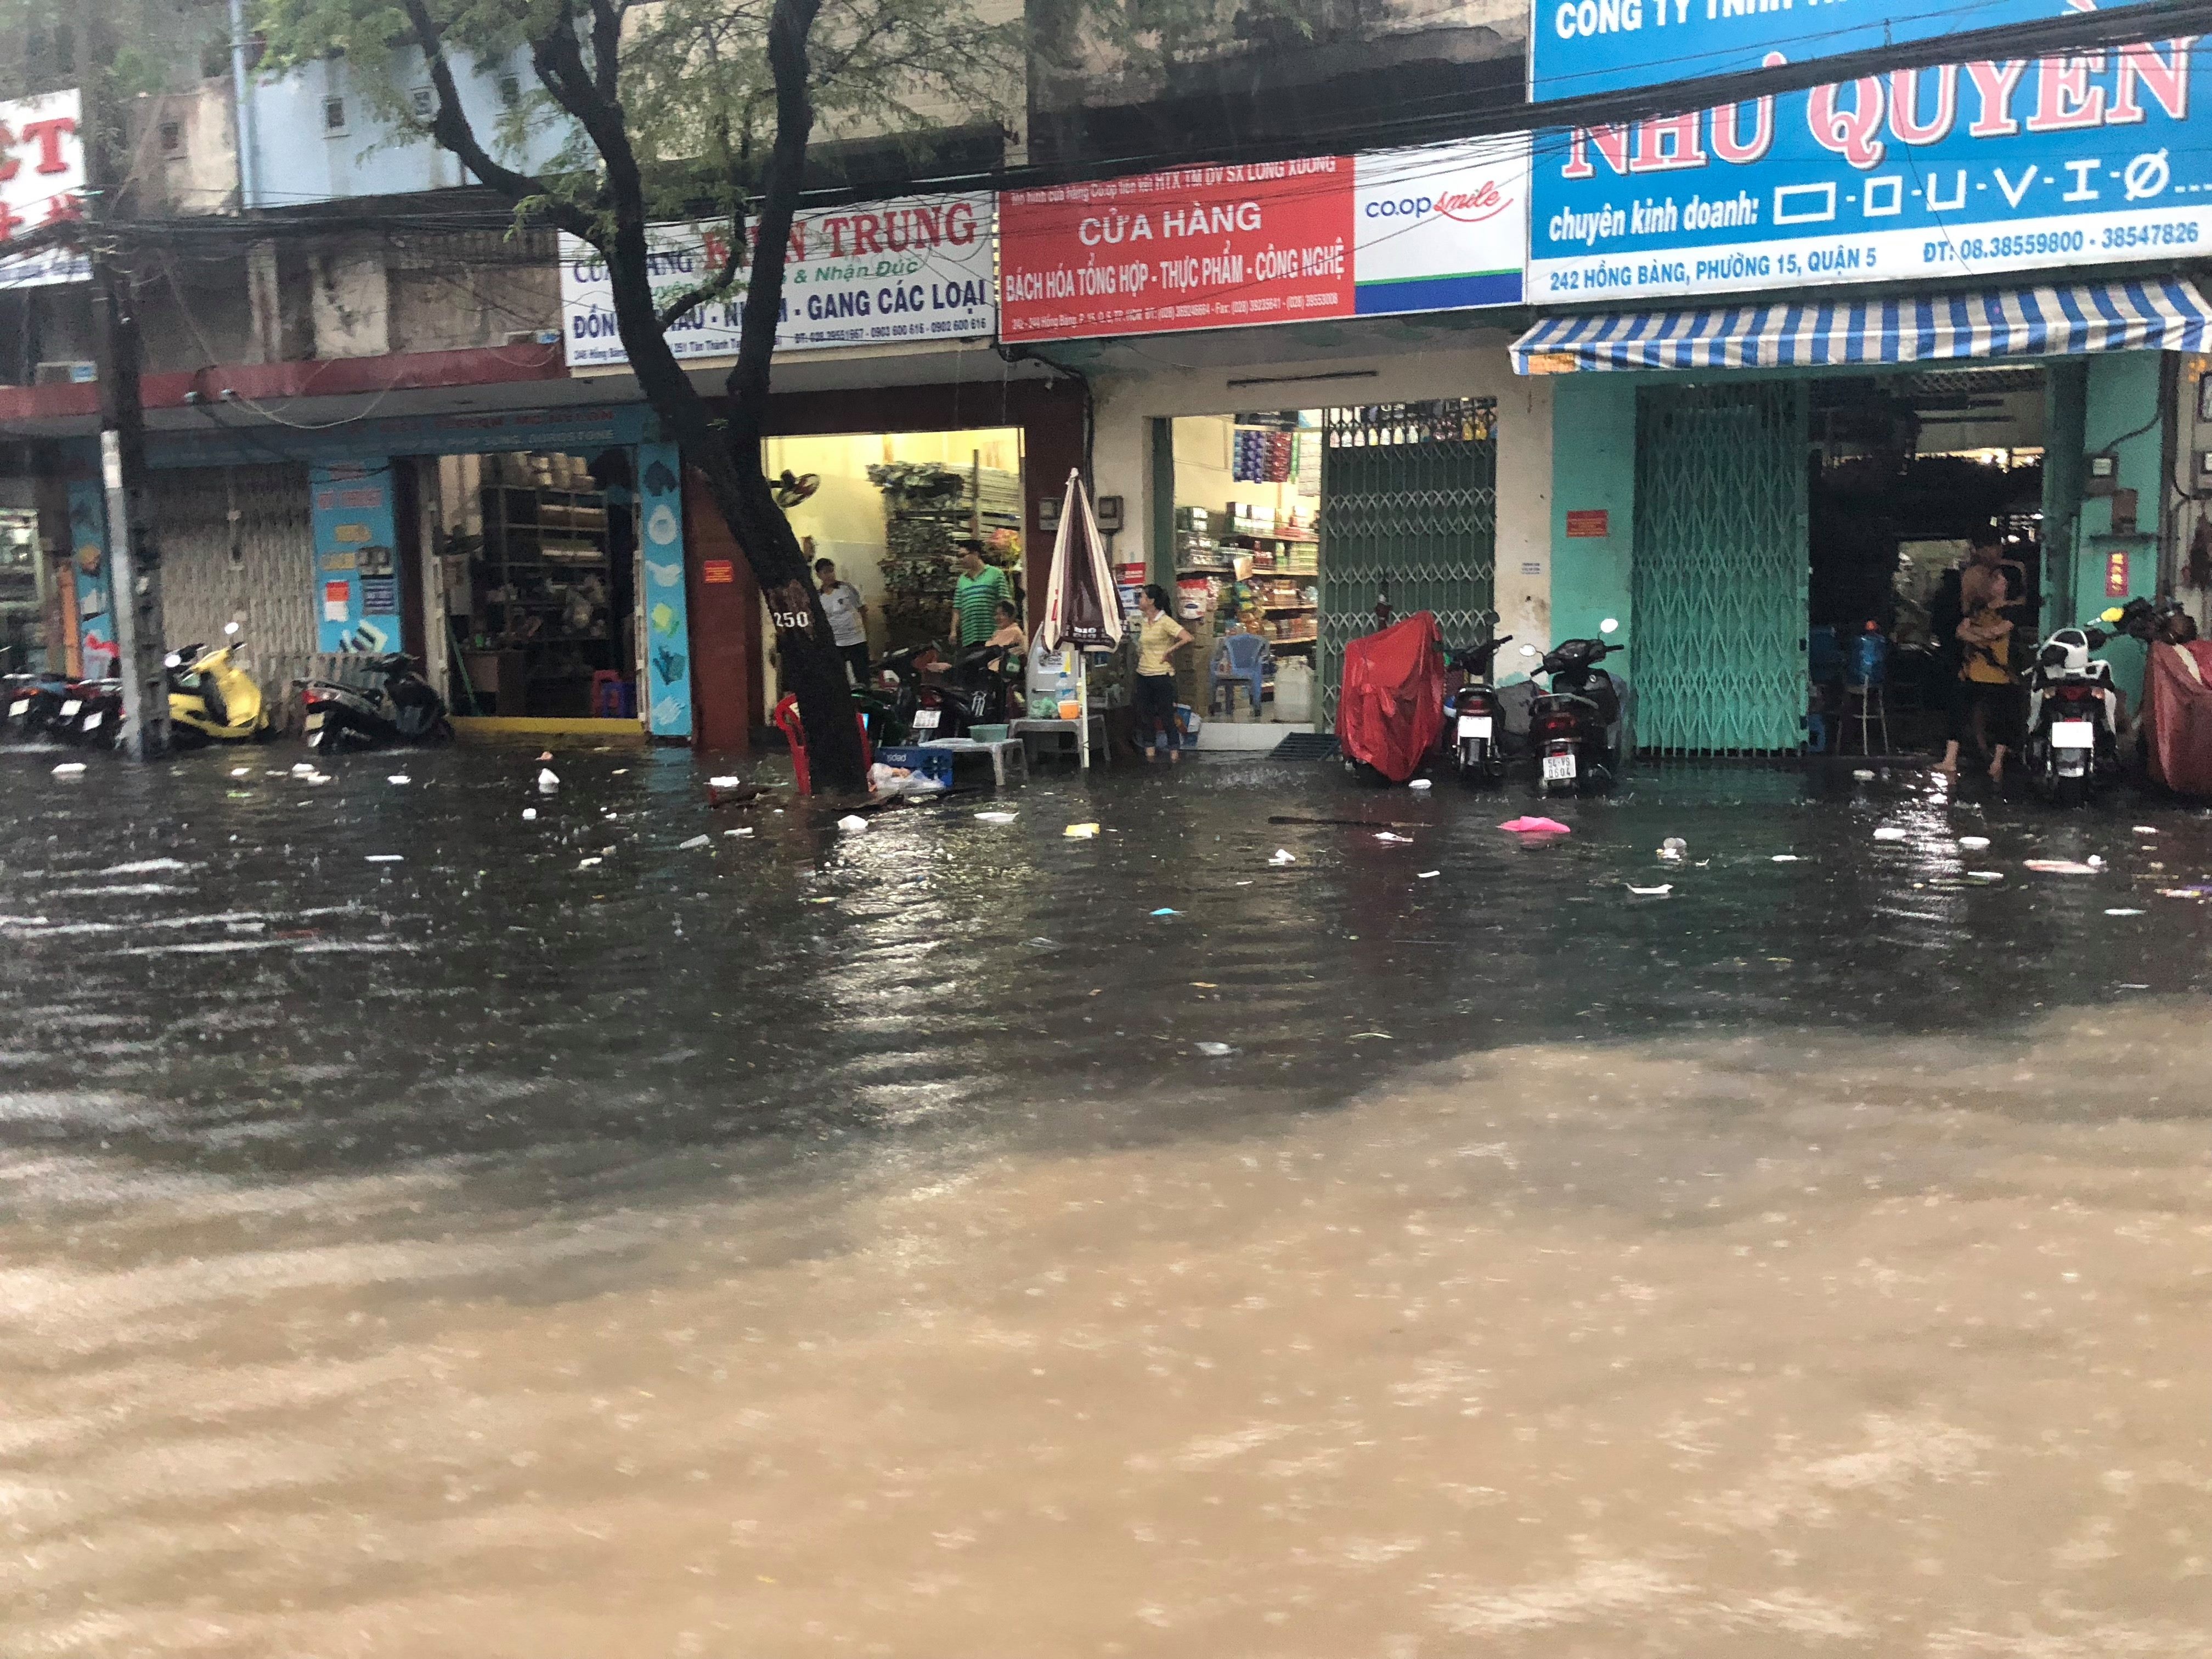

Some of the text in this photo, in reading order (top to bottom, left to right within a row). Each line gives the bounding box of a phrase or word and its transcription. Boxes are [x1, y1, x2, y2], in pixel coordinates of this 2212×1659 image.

[823, 202, 978, 258] TRUNG
[1079, 200, 1261, 245] CỬA HÀNG
[1549, 189, 1760, 246] chuyên kinh doanh:
[1960, 230, 2084, 260] 08.38559800
[2102, 221, 2200, 250] 38547826
[1005, 236, 1345, 302] BÁCH HÓA TỔNG HỢP THỰC PHẨM CÔNG NGHỆ
[1550, 245, 1877, 291] 242 HỒNG BÀNG, PHƯỜNG 15, QUẬN 5
[808, 290, 871, 320] GANG
[878, 280, 925, 314] CÁC
[932, 279, 987, 314] LOẠI
[774, 611, 809, 628] 250
